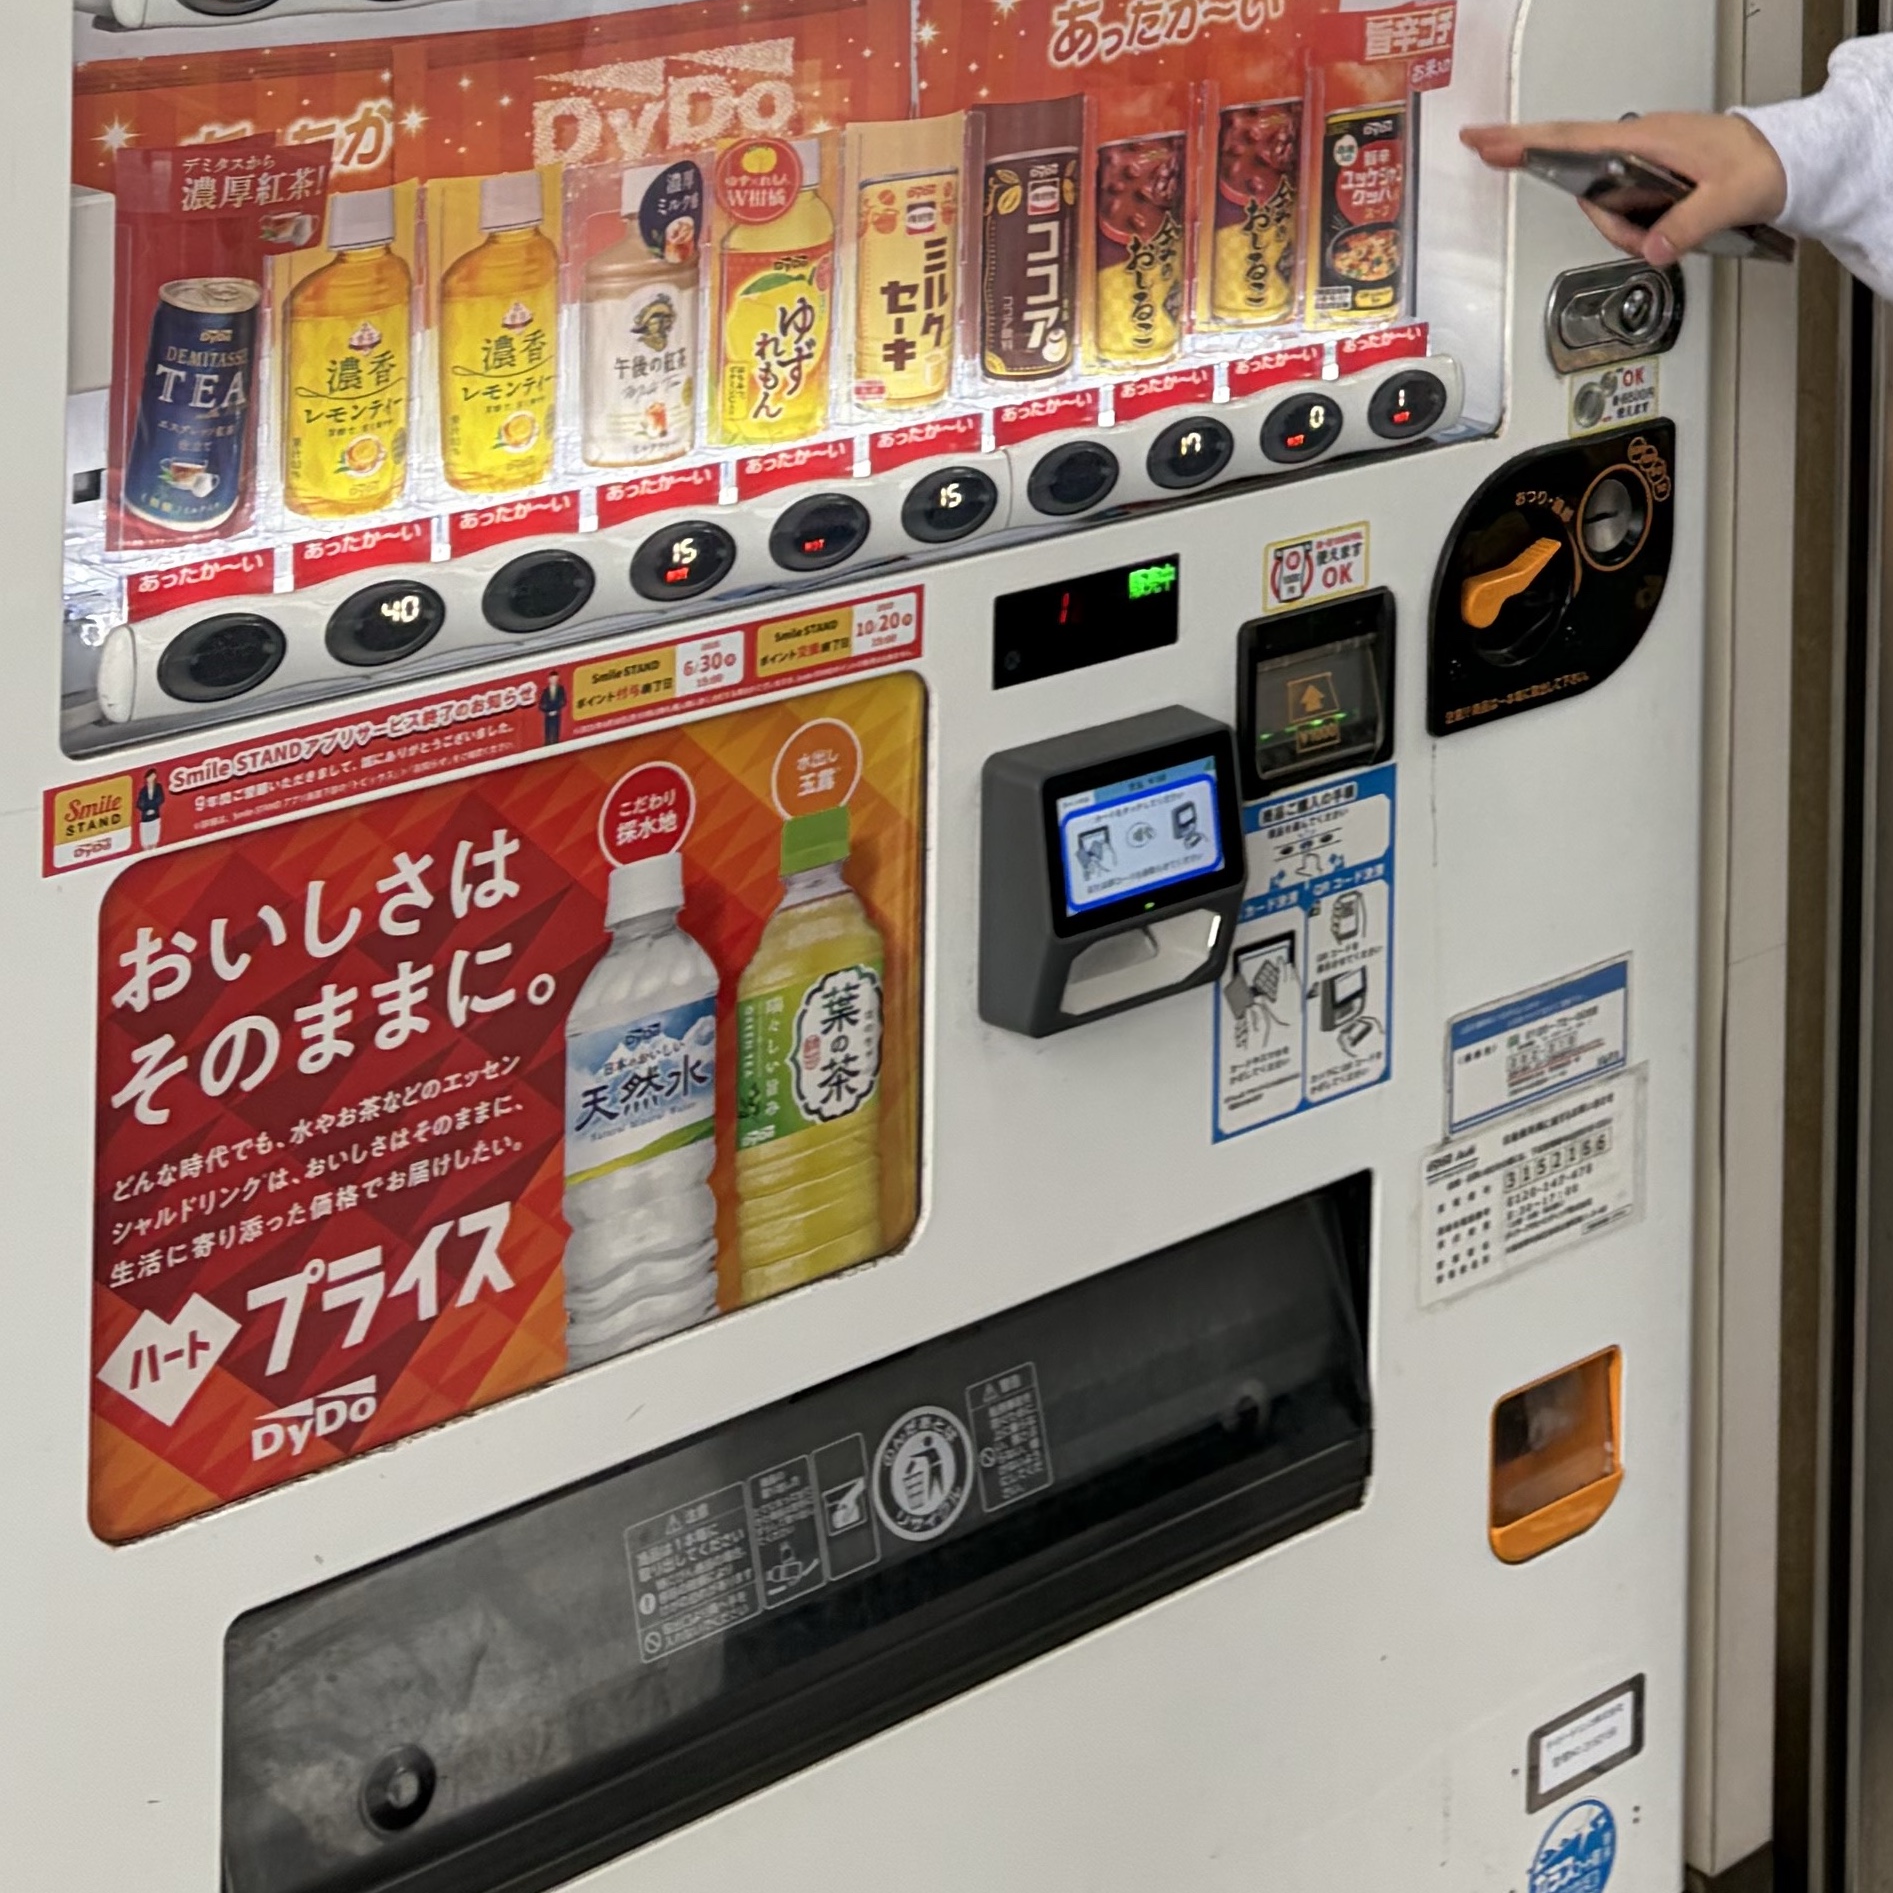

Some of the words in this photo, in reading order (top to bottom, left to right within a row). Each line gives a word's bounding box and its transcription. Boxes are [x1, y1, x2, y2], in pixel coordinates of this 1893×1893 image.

[180, 169, 326, 212] 濃厚紅茶!
[920, 236, 949, 350] ミルク
[1022, 219, 1061, 351] ココア
[777, 296, 818, 396] ゆず
[880, 279, 921, 373] セーキ
[326, 349, 396, 395] 濃香
[481, 328, 547, 373] 濃香
[614, 348, 688, 380] 午後の紅茶
[155, 363, 247, 409] TEA
[461, 373, 557, 403] レモンティー
[751, 331, 784, 421] れもん
[1622, 366, 1645, 388] OK
[304, 397, 404, 425] レモンティー
[1309, 405, 1326, 429] 0
[1321, 562, 1355, 591] OK
[380, 595, 420, 623] 40
[170, 757, 232, 793] Smile
[64, 795, 123, 823] Smile
[65, 813, 122, 837] STAND
[618, 789, 677, 819] こだわり
[615, 811, 679, 847] 採水地
[109, 828, 523, 1016] おいしさは
[109, 937, 557, 1128] そのままに。
[819, 983, 861, 1107] 葉の茶
[603, 1041, 686, 1079] 日本のおいしい
[574, 1055, 709, 1133] 天然水
[111, 1054, 522, 1204] どんな時代でも、水やお茶などのエッセン
[108, 1135, 524, 1289] 生活に寄り添った価格でお届けしたい。
[246, 1200, 517, 1378] プライス
[128, 1328, 211, 1391] ハート
[250, 1393, 378, 1463] DyDo
